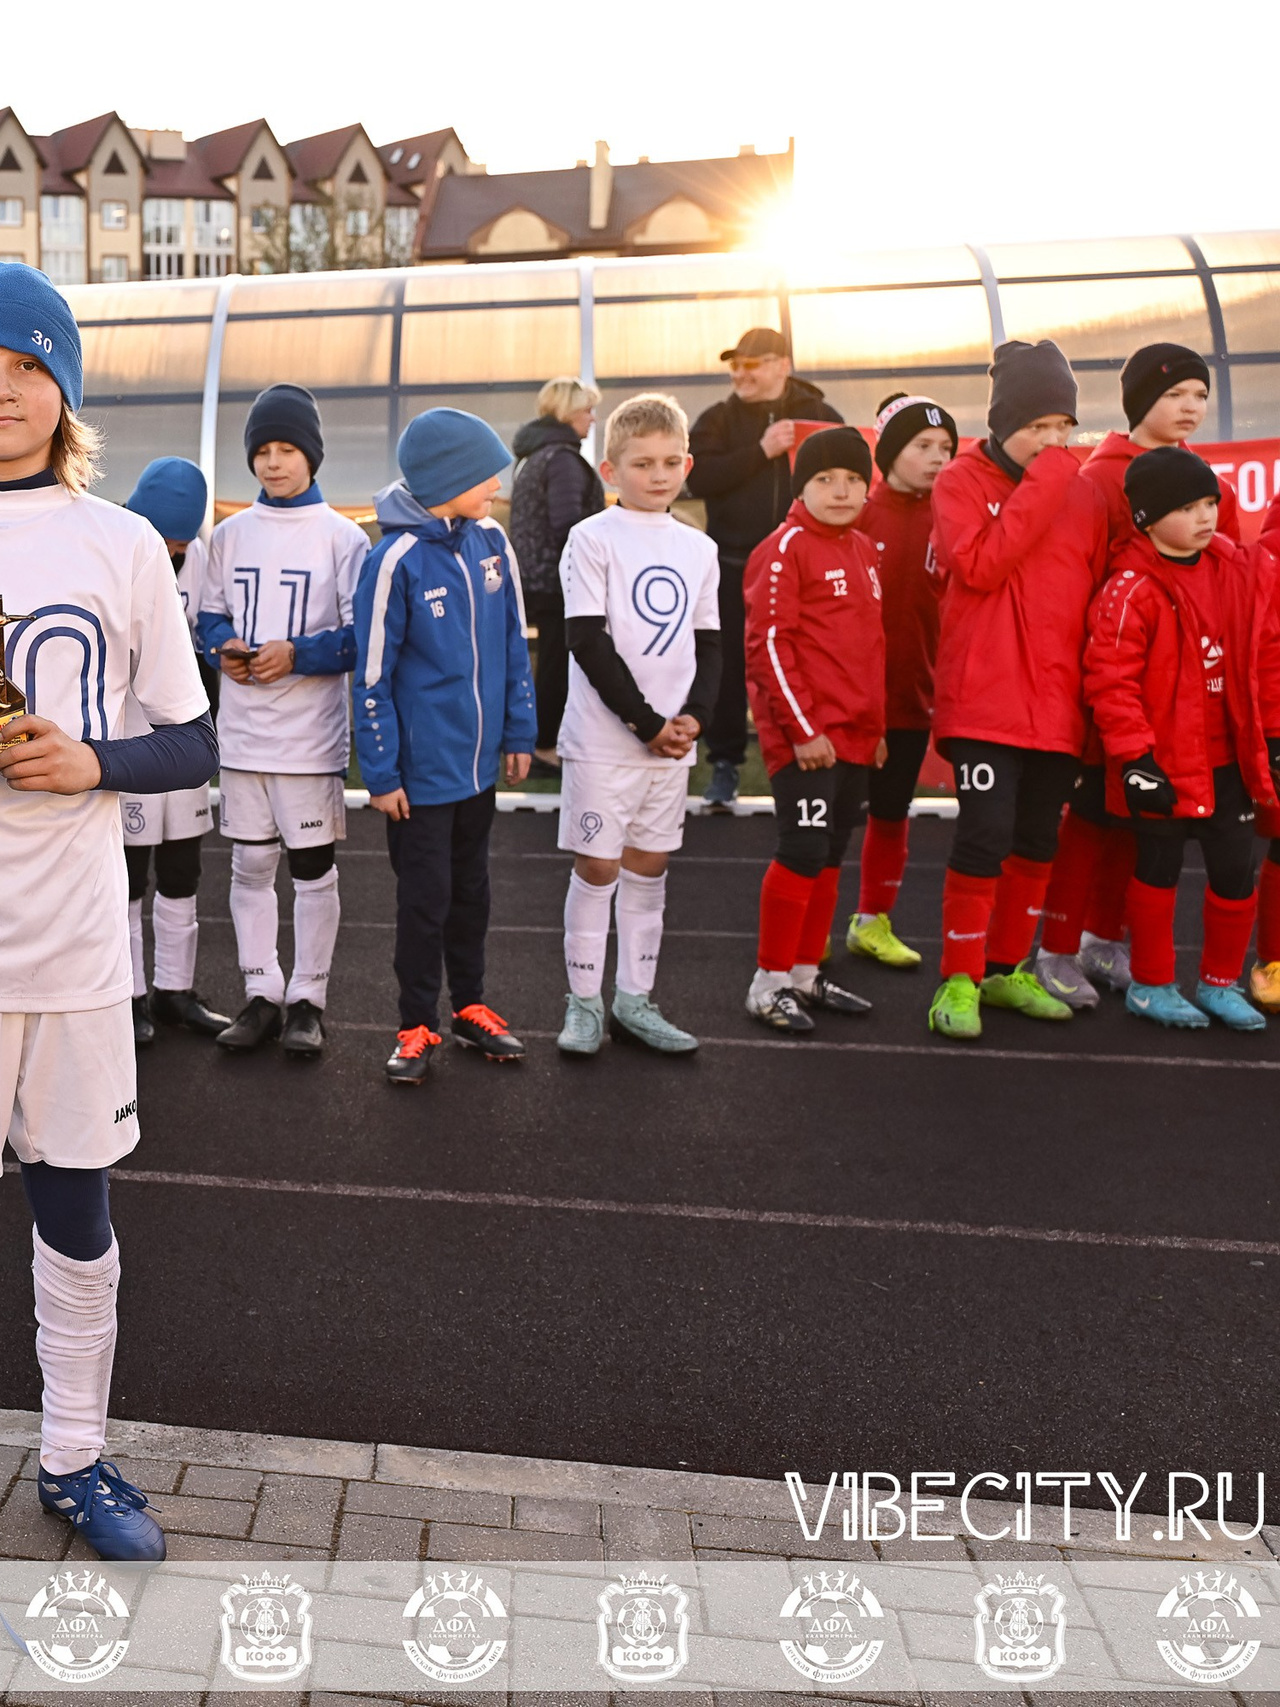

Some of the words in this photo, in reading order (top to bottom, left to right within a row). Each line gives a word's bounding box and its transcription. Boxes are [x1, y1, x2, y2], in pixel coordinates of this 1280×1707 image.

[31, 329, 52, 353] 30
[424, 586, 448, 601] JAKO
[832, 579, 848, 596] 12
[234, 567, 311, 648] 11
[430, 600, 445, 618] 16
[631, 566, 688, 656] 9
[960, 763, 995, 791] 10
[300, 820, 323, 830] JAKO
[796, 798, 828, 828] 12
[580, 812, 603, 844] 9
[114, 1099, 137, 1125] JAKO
